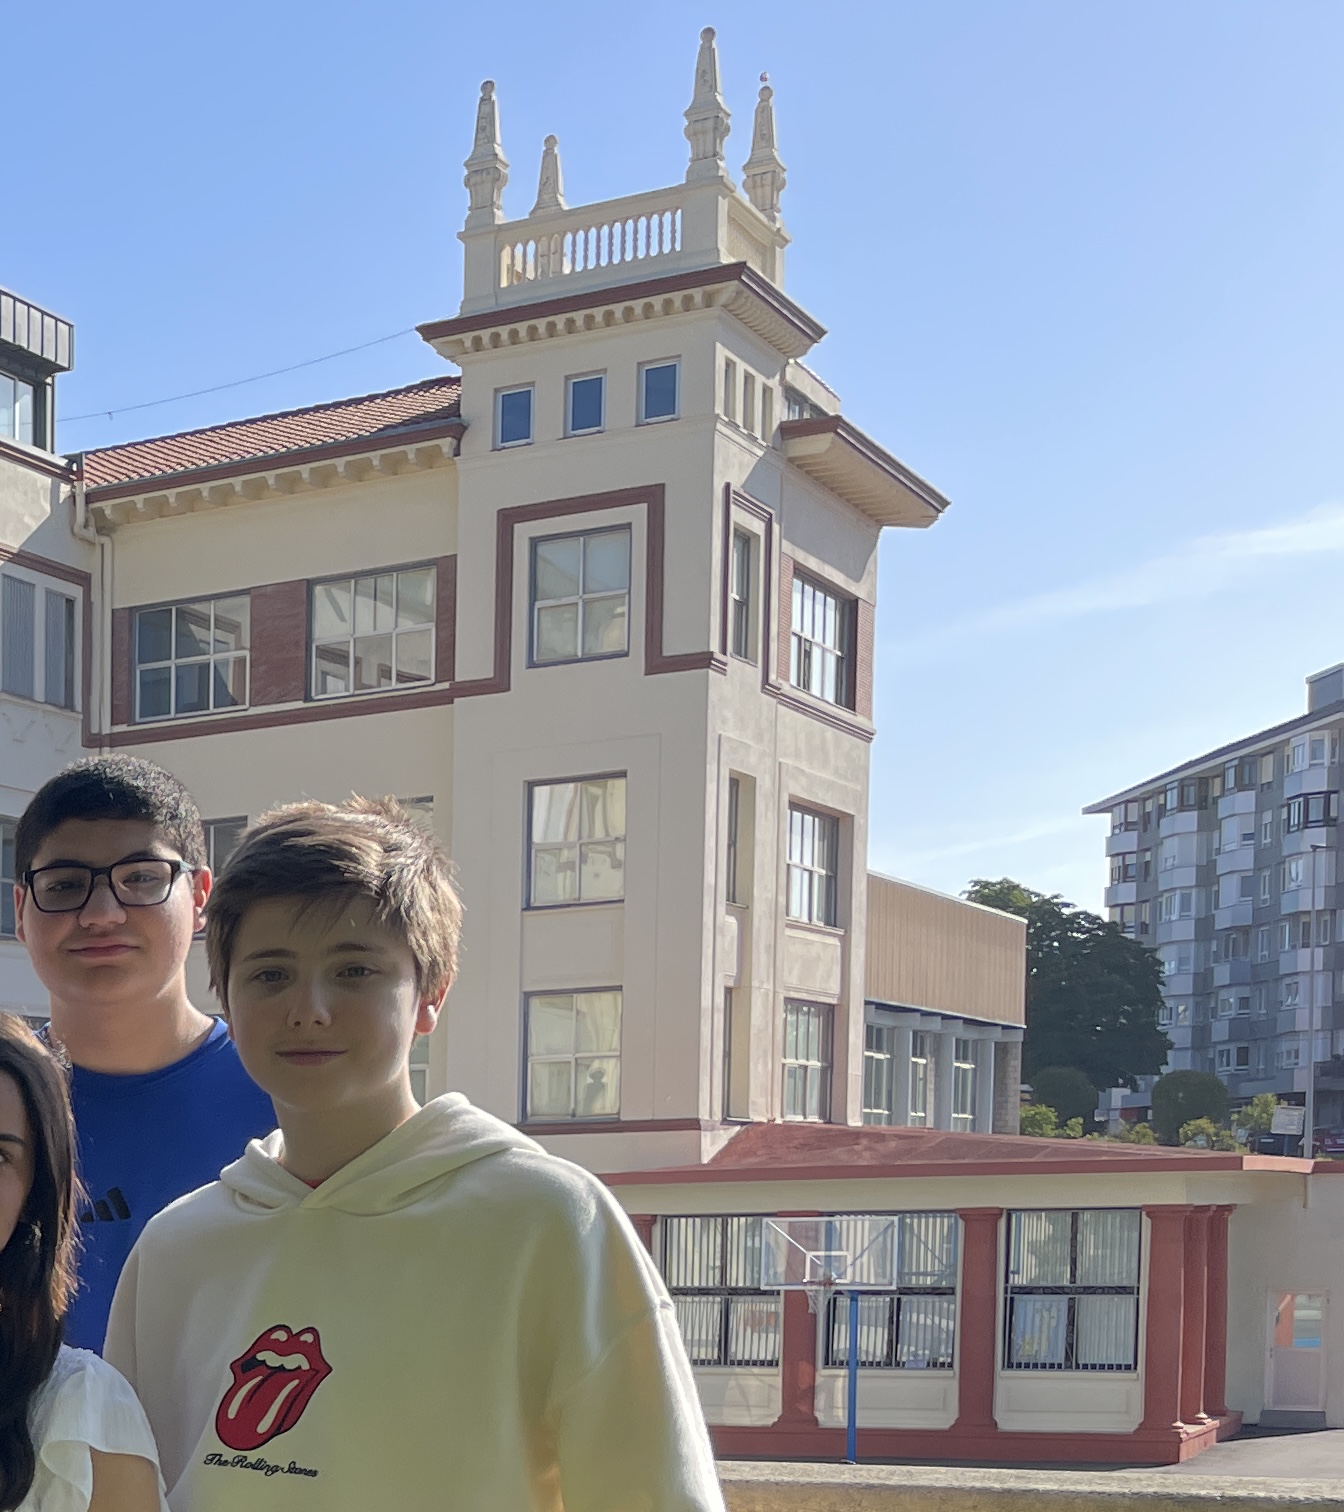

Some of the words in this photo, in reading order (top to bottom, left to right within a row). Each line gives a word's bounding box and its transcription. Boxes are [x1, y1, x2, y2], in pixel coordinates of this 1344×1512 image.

[203, 1453, 230, 1466] The
[231, 1455, 280, 1476] Rolling
[280, 1461, 318, 1477] Stones
